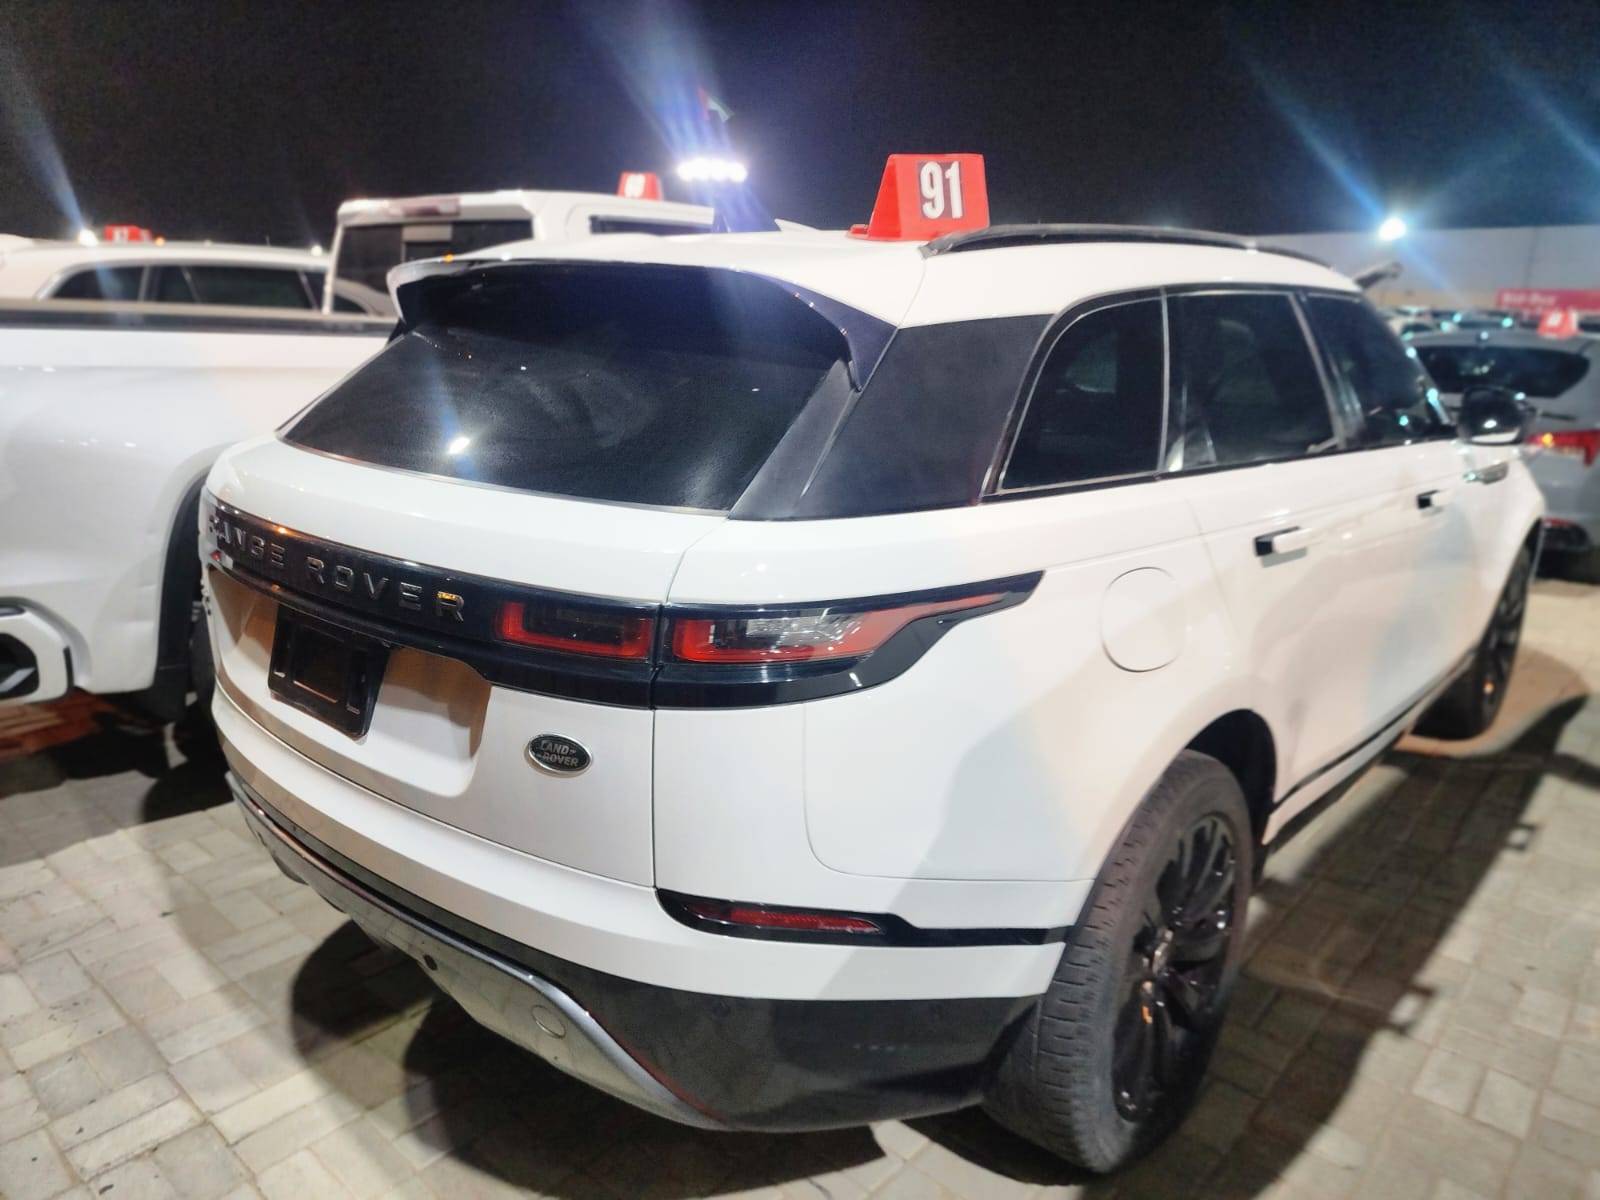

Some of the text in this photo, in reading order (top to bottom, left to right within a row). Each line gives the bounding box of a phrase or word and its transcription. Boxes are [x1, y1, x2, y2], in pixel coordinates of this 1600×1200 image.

[920, 161, 963, 219] 91
[305, 555, 465, 623] ROVER
[543, 751, 578, 767] ROVER
